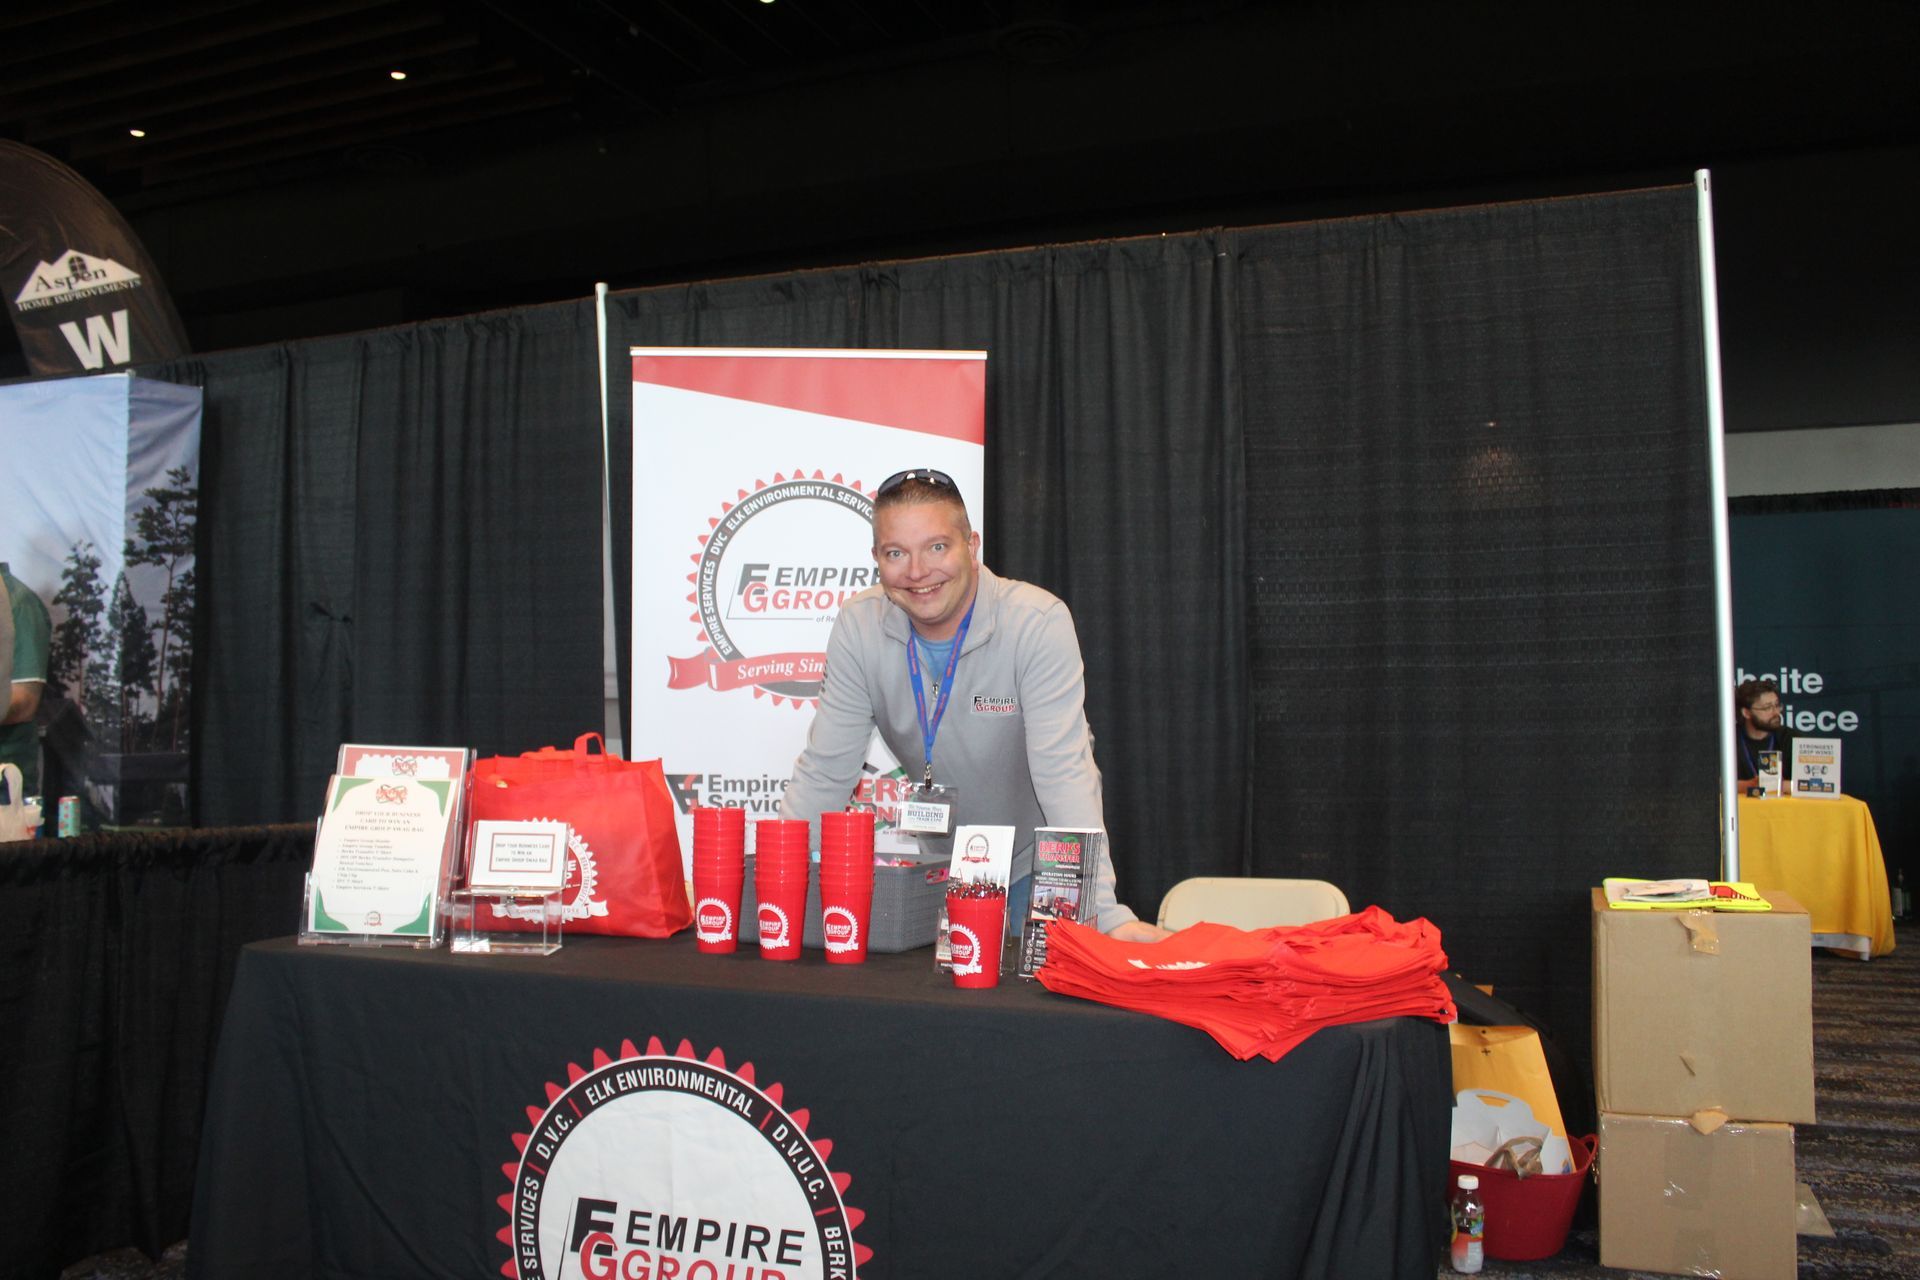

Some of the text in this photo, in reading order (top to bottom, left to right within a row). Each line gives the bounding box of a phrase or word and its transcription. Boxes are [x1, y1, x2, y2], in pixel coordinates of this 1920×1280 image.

[18, 278, 142, 312] HOME IMPROVEMENTS
[35, 266, 108, 293] Aspen
[58, 309, 132, 371] W
[725, 485, 874, 531] ELK ENVIRONMENTAL SERVIC
[710, 531, 729, 556] DVC
[702, 560, 733, 656] EMPIRE SERVICES
[737, 657, 823, 680] Serving Sin
[984, 697, 1016, 705] EMPIRE
[985, 704, 1014, 712] GROUP
[1780, 705, 1859, 732] iece
[708, 774, 792, 797] Empire
[708, 794, 782, 813] Servic
[907, 810, 944, 819] BUILDING
[585, 1067, 753, 1119] ELK ENVIRONMENTAL
[534, 1113, 573, 1160] D.V.C.
[771, 1123, 826, 1201] D.V.U.C.
[520, 1176, 540, 1270] SERVICES
[625, 1210, 806, 1267] EMPIRE
[824, 1226, 847, 1280] BERK
